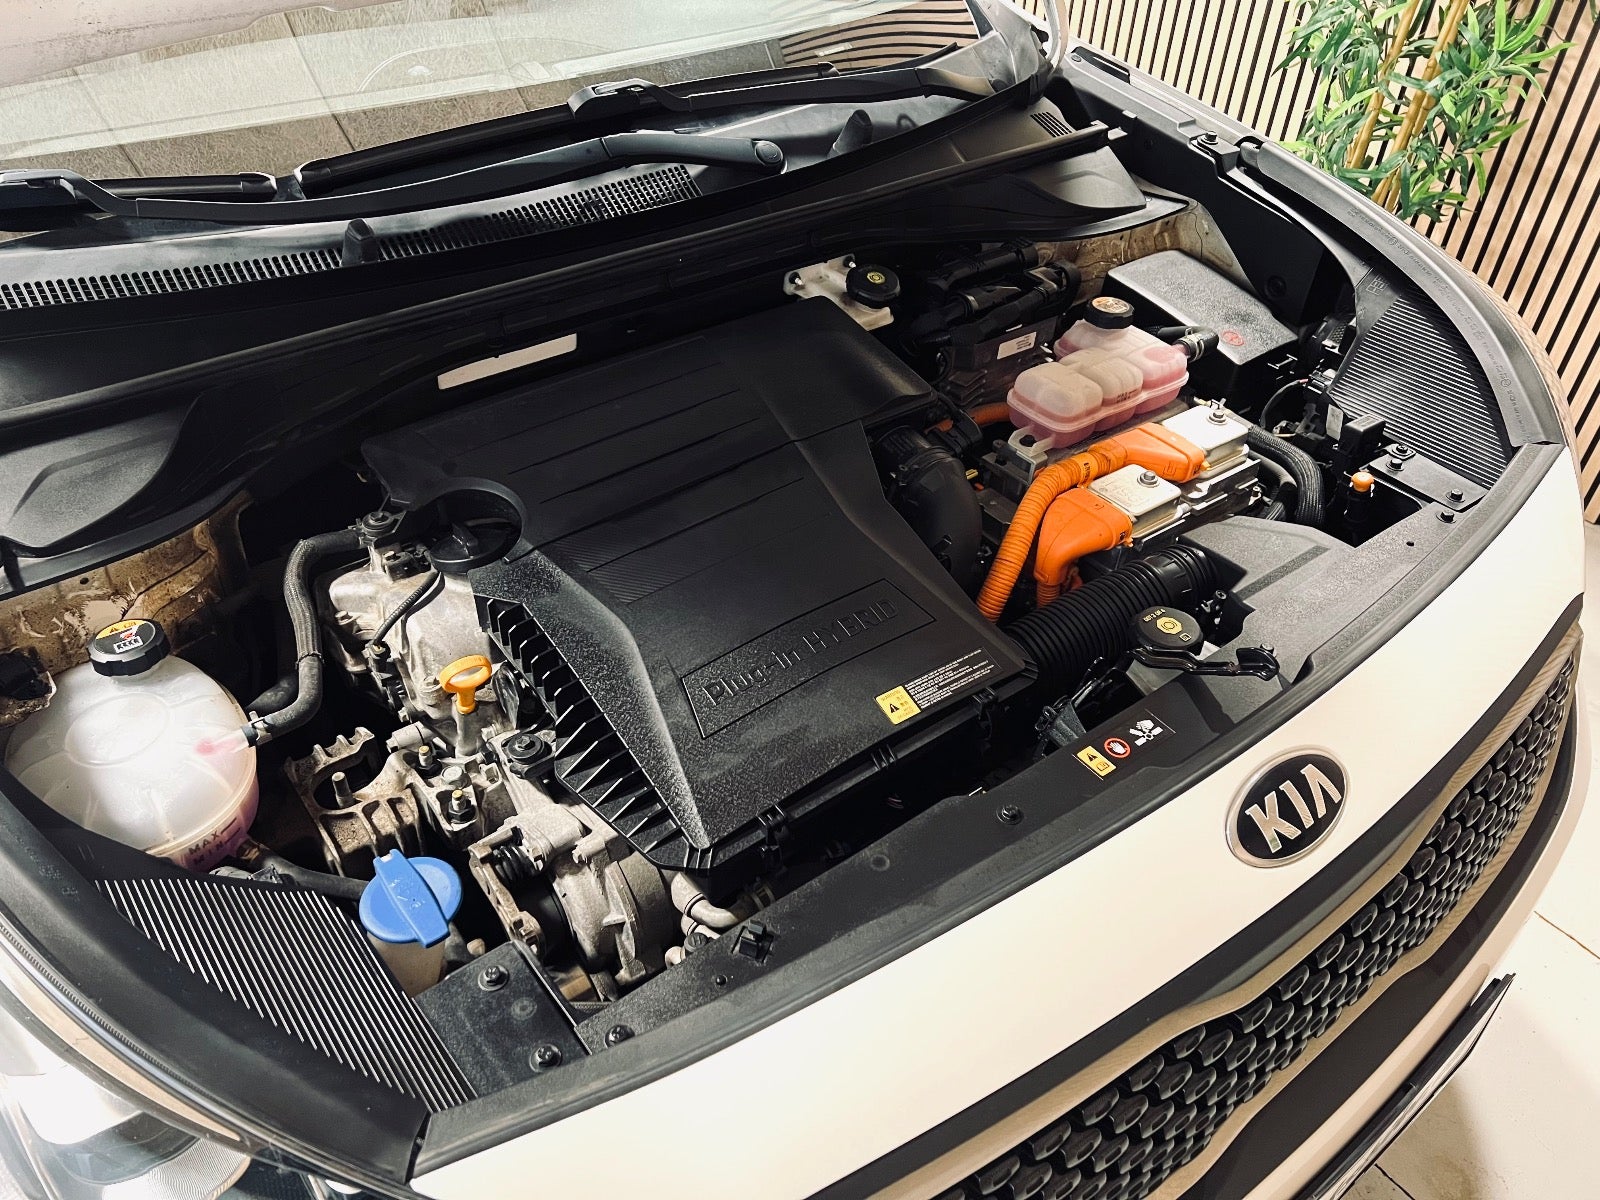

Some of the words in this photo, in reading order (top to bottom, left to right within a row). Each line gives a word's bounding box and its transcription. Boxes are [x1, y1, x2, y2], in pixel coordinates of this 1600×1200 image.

[702, 650, 803, 706] Plug-in
[802, 598, 899, 654] HYBRID
[188, 829, 220, 855] MAX
[1244, 763, 1342, 854] KIA
